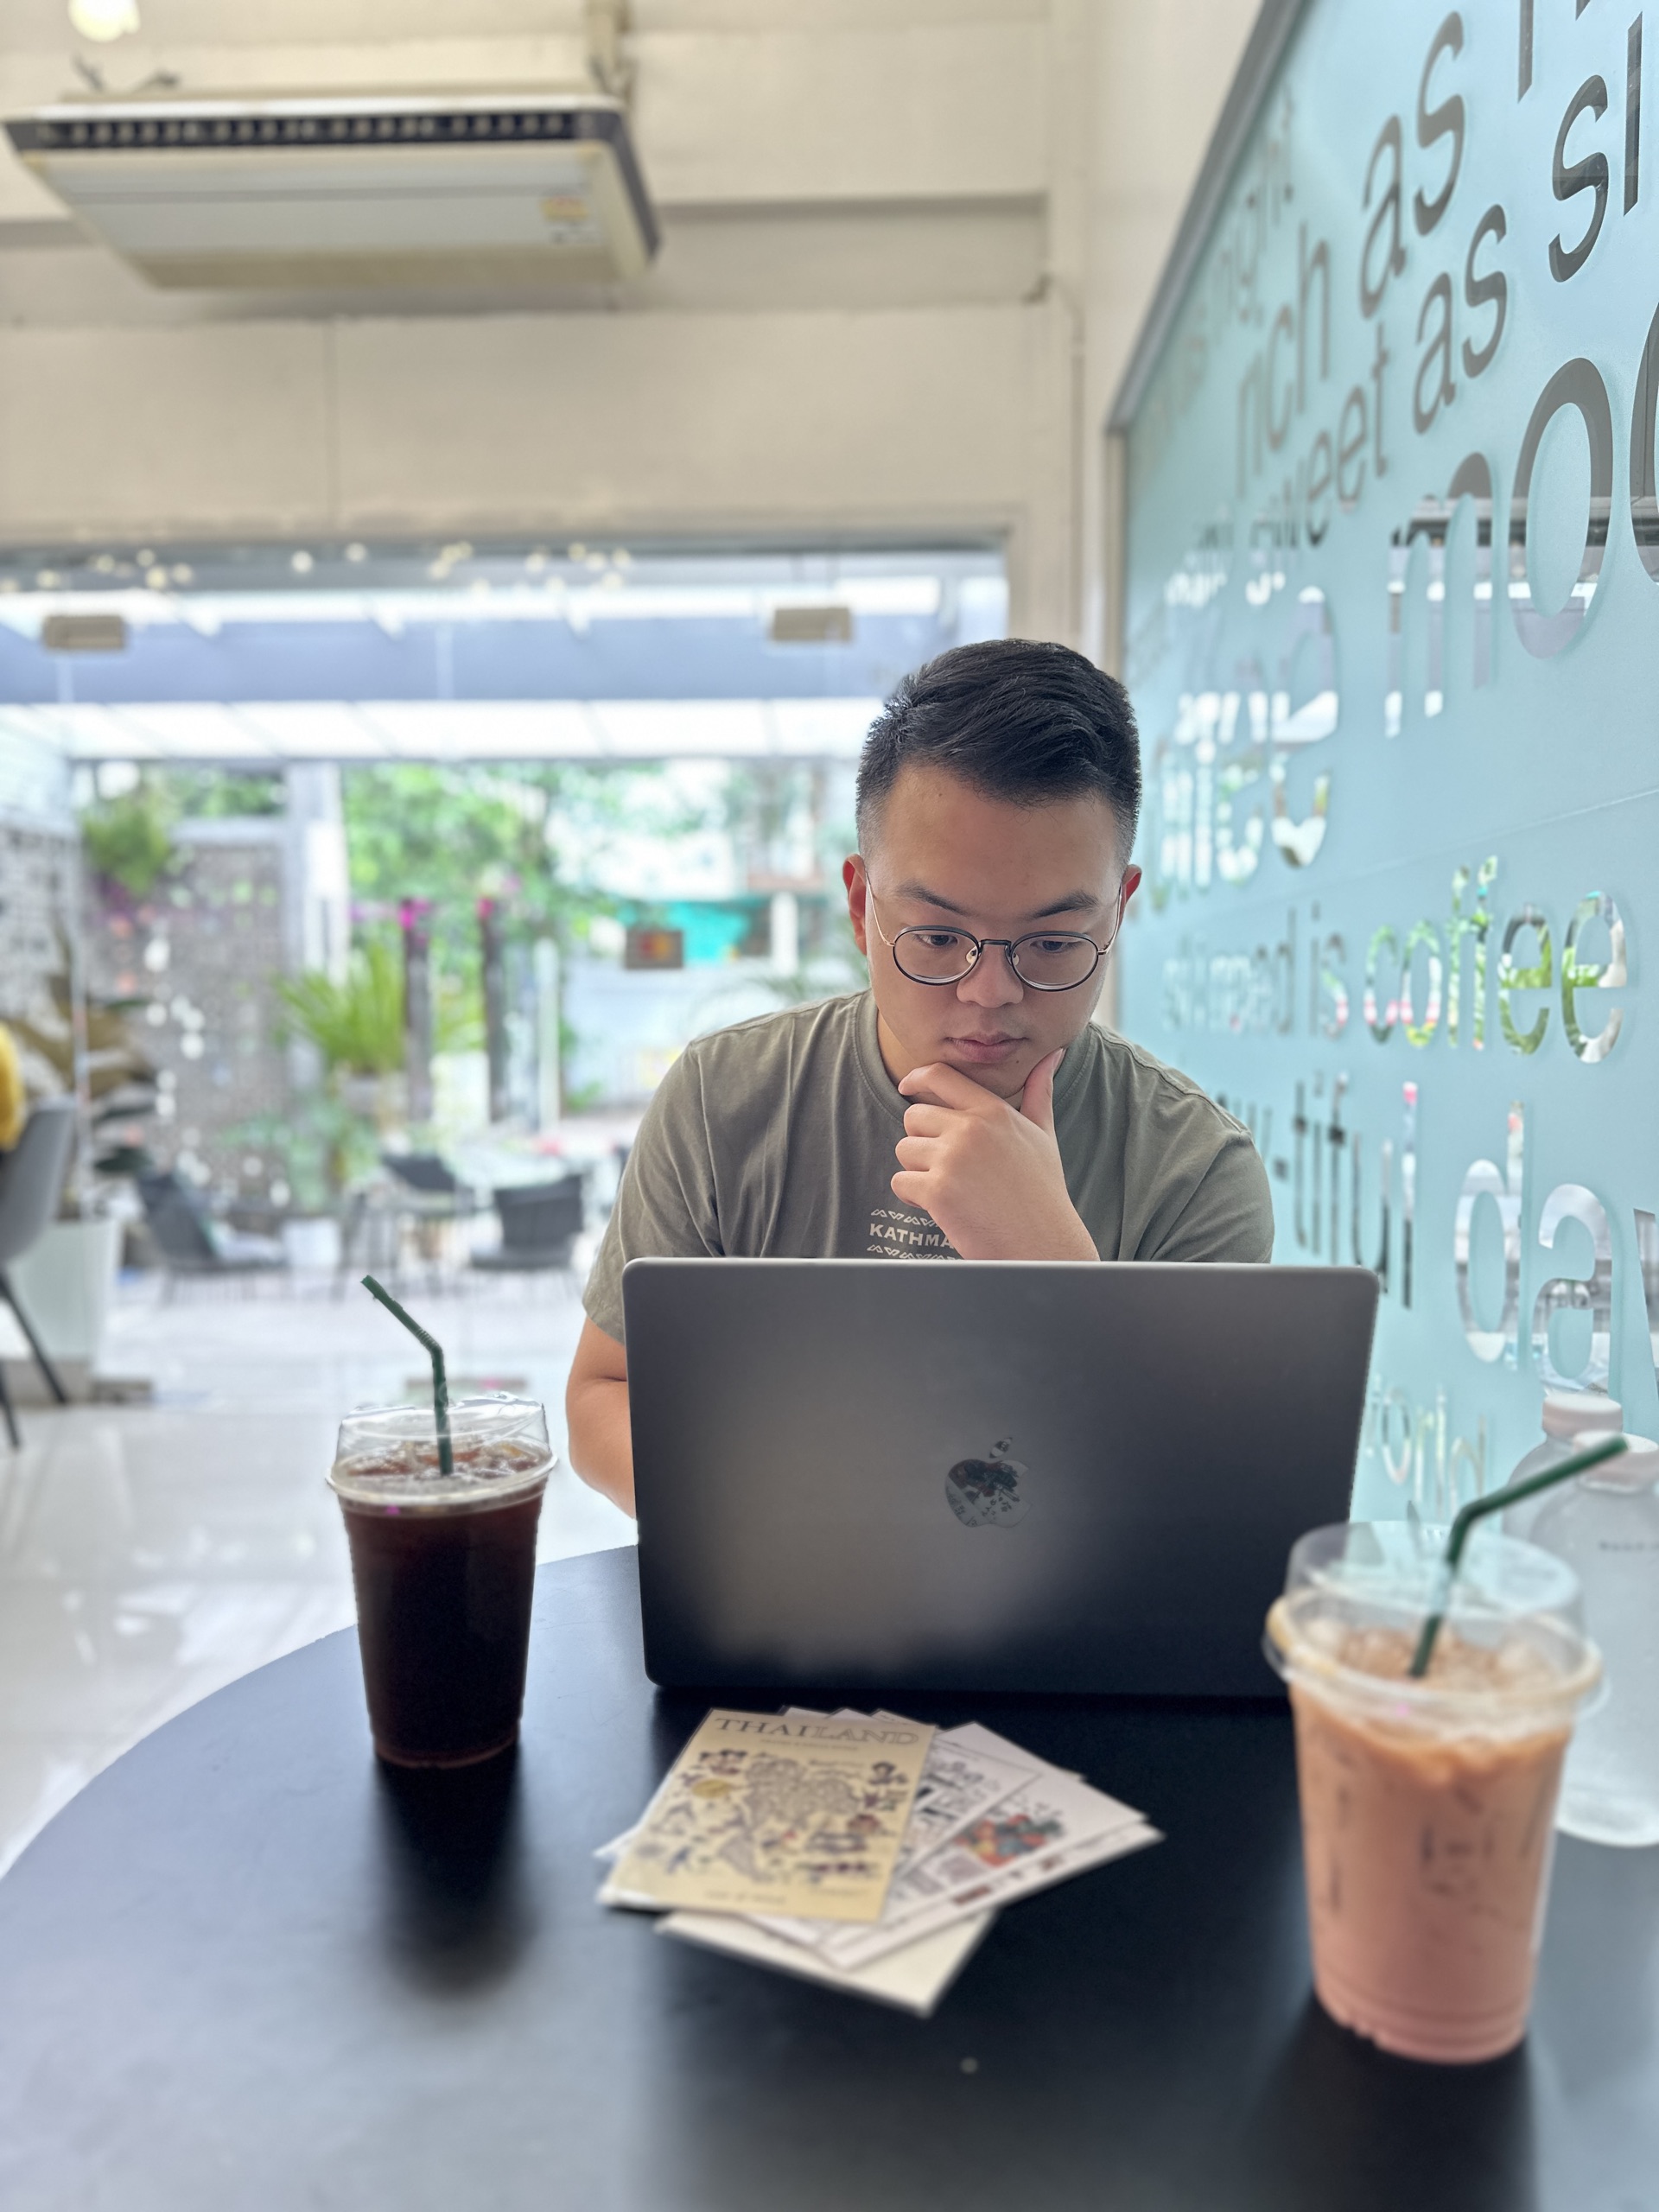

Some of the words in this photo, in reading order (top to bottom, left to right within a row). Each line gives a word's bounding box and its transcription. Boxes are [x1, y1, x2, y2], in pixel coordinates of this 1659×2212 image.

[1359, 10, 1465, 321] as
[1412, 203, 1508, 434] as
[1384, 294, 1659, 740] mo
[1307, 899, 1350, 1043] is
[1363, 855, 1629, 1063] coffee
[1454, 1100, 1659, 1402] da
[714, 1717, 919, 1745] THAILAND
